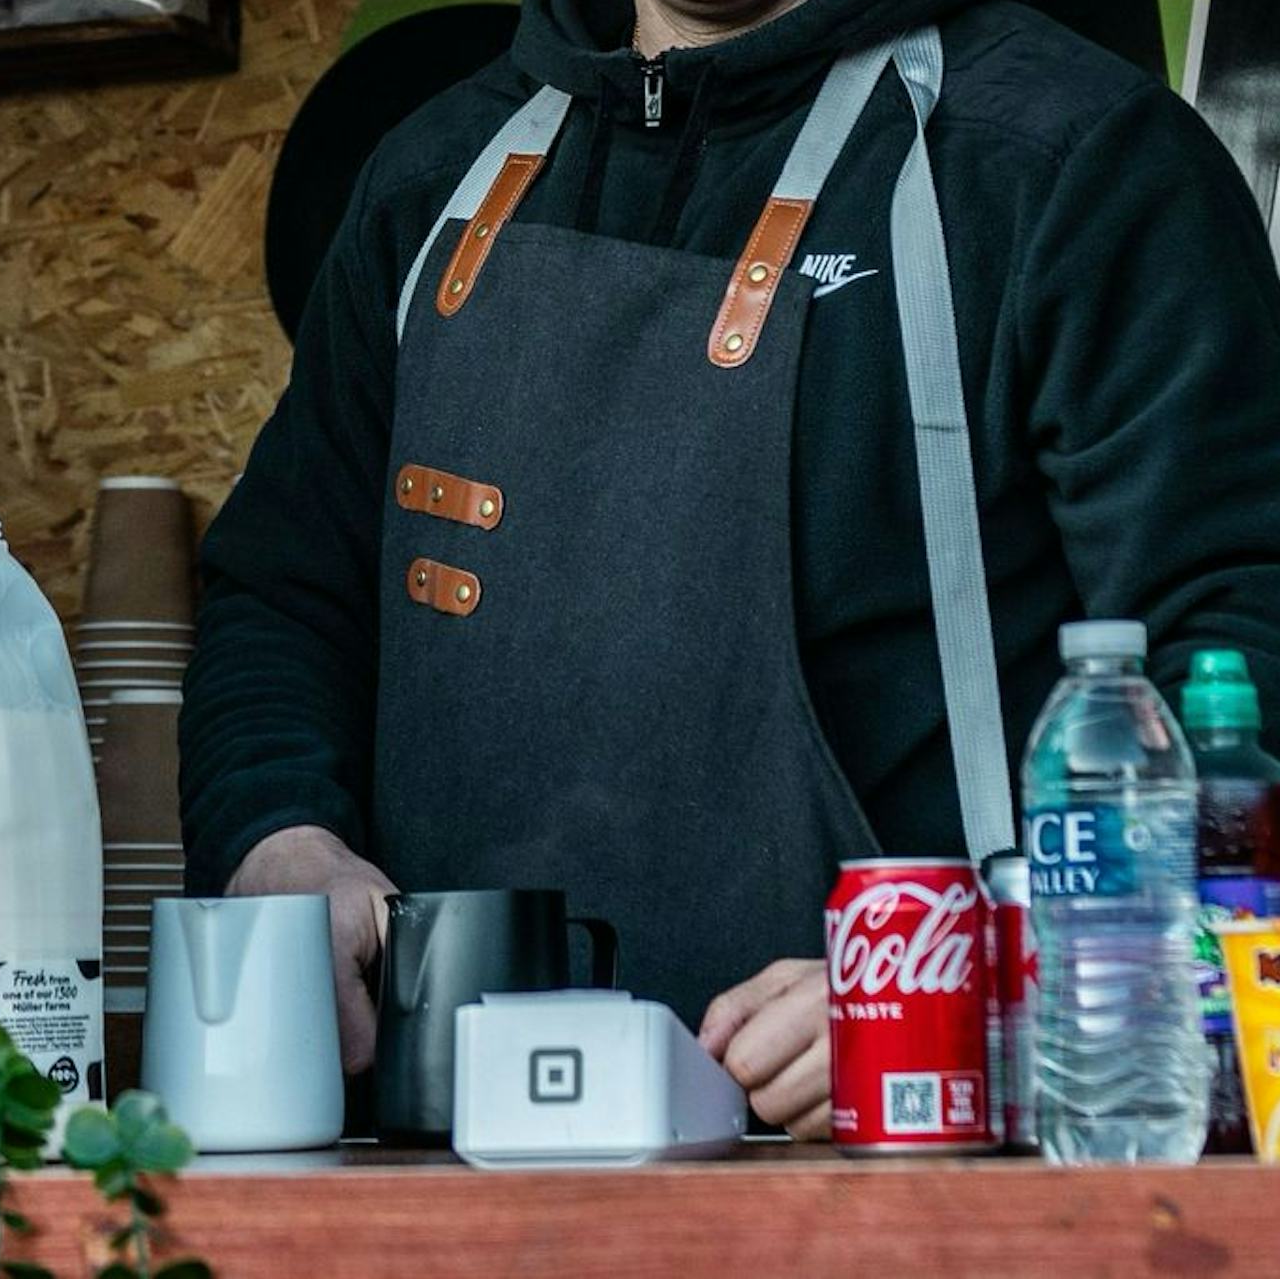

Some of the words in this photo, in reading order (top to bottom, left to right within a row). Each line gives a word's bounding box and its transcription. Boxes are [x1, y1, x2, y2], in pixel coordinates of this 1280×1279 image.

[798, 253, 858, 285] NIKE
[13, 969, 47, 987] Fresh
[49, 974, 70, 984] from
[2, 991, 21, 1000] one
[24, 989, 35, 999] of
[36, 990, 53, 999] our
[12, 1001, 42, 1012] Müller
[45, 1001, 71, 1011] farms
[847, 1001, 904, 1020] TASTE
